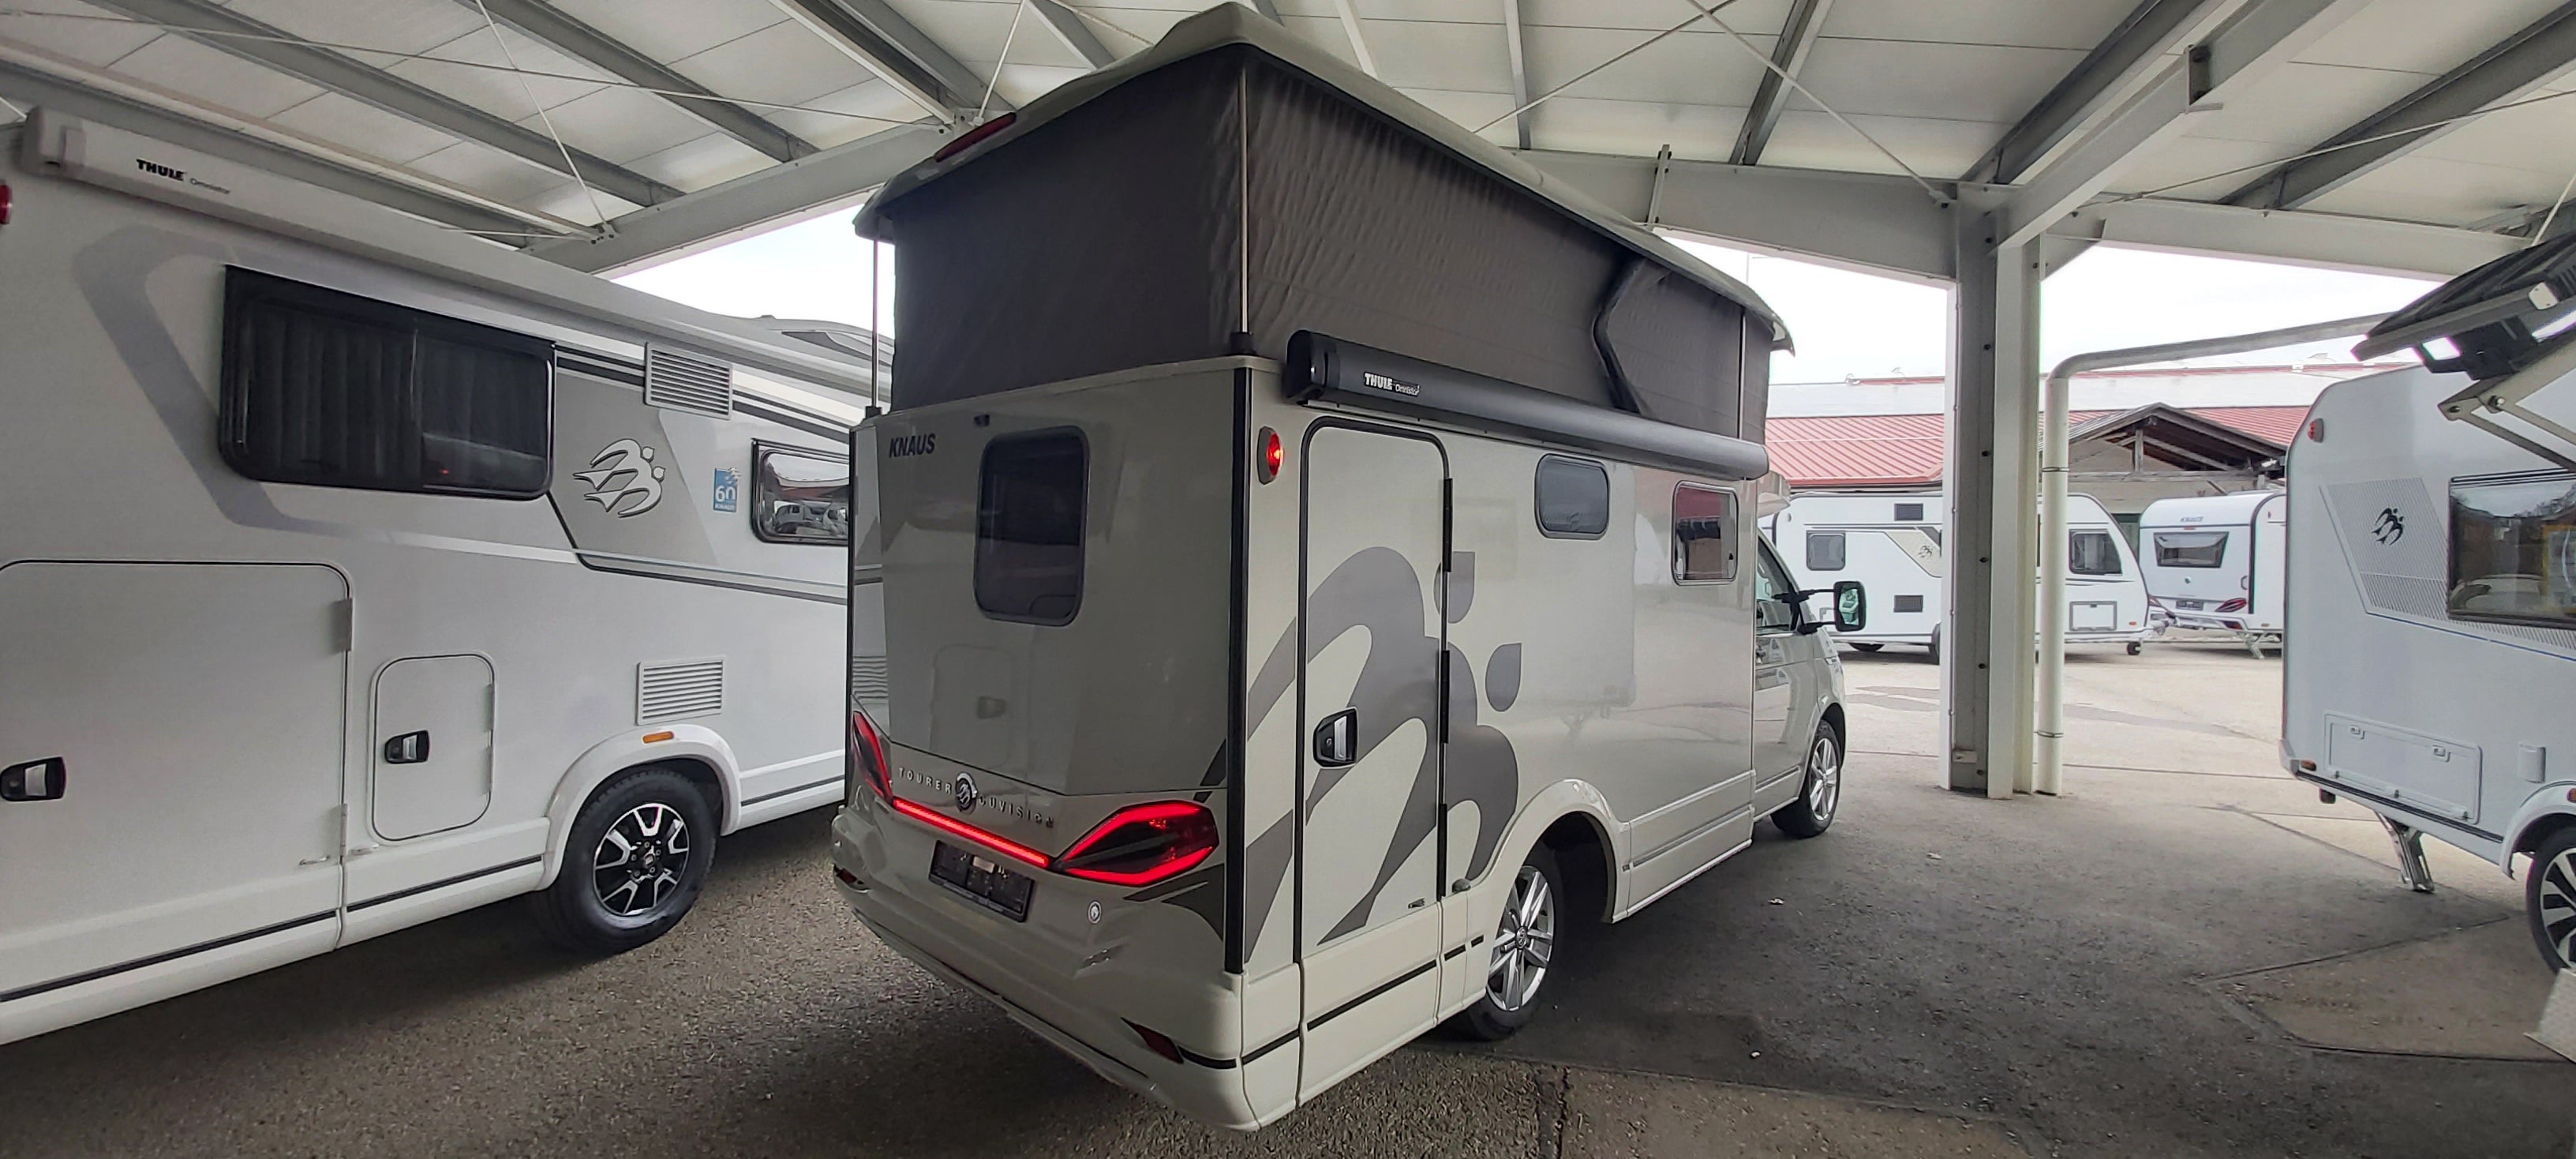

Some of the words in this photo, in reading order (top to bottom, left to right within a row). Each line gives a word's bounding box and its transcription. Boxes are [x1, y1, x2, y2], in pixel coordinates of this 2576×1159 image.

[136, 159, 184, 182] THULE
[1365, 373, 1392, 390] THULE
[889, 433, 936, 458] KNAUS
[899, 767, 952, 794] TOURER
